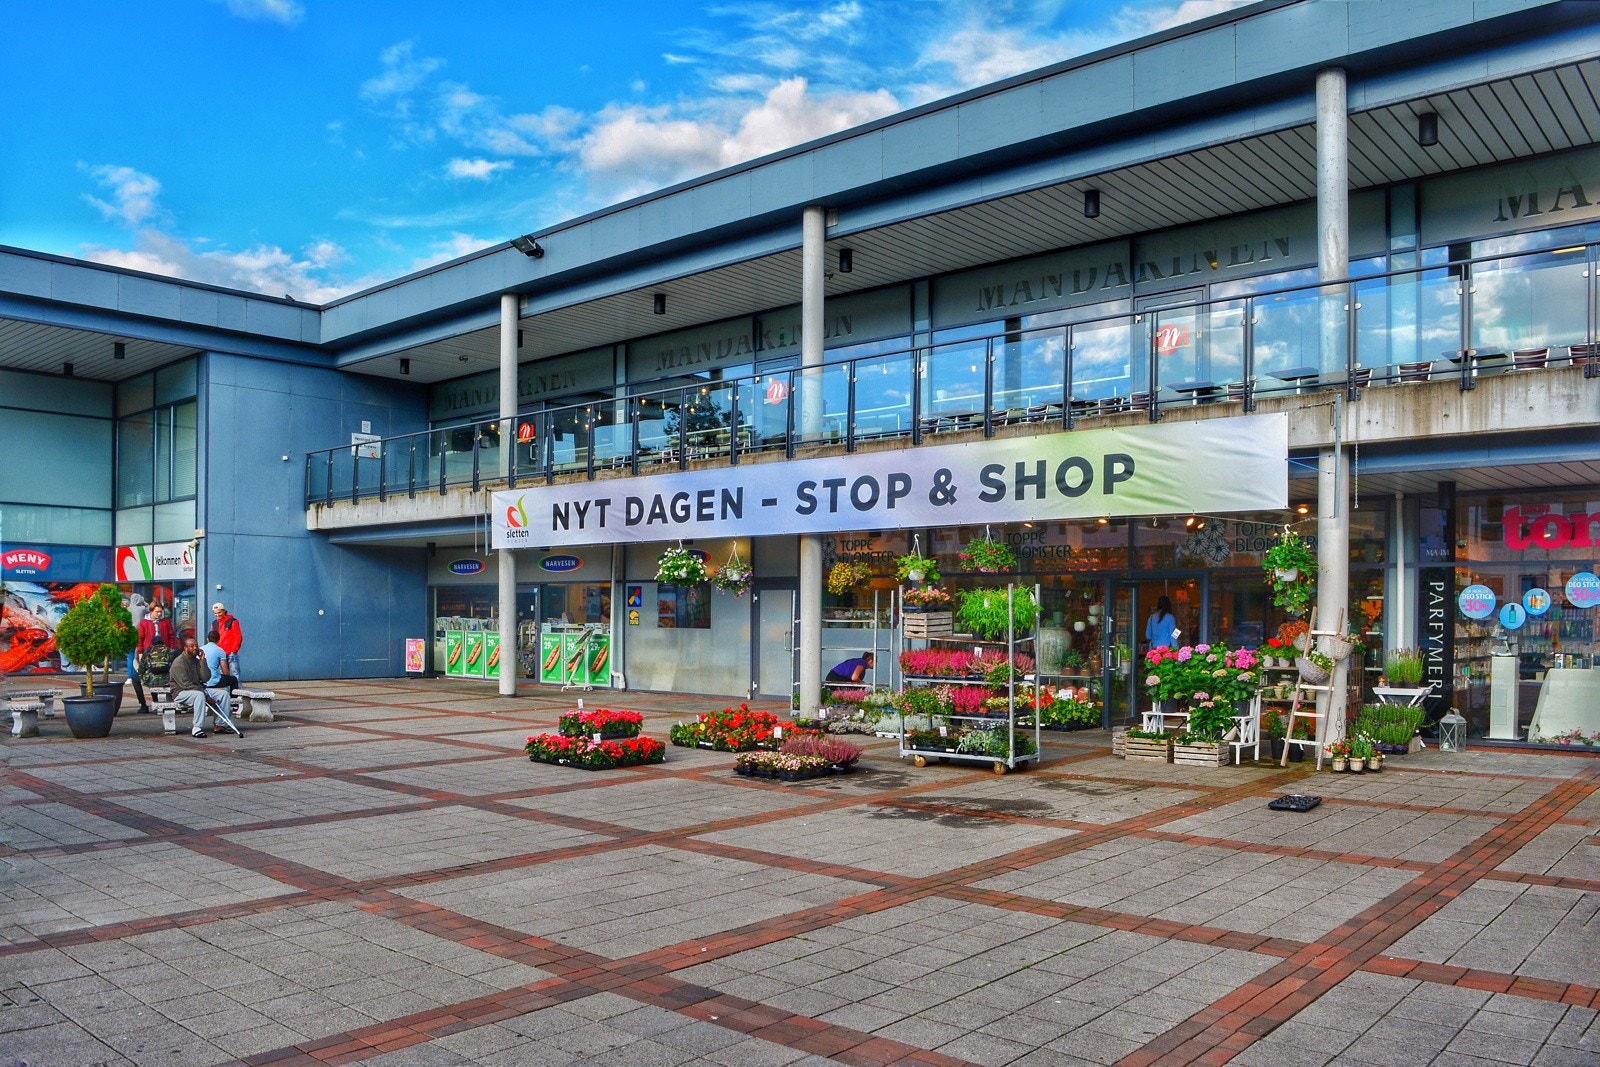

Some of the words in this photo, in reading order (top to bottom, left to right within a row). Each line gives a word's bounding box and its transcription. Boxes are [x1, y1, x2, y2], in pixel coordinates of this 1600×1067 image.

[1493, 168, 1600, 222] MA
[552, 498, 612, 531] NYT
[625, 487, 744, 526] DAGEN
[795, 472, 912, 515] STOP
[928, 467, 958, 507] &
[978, 453, 1136, 503] SHOP
[506, 529, 529, 538] sletten
[1005, 531, 1046, 545] TOPPE
[840, 538, 873, 551] TOPPE
[6, 553, 46, 565] MENY
[155, 556, 181, 566] Velkommen
[1428, 582, 1444, 699] PARFYMERI
